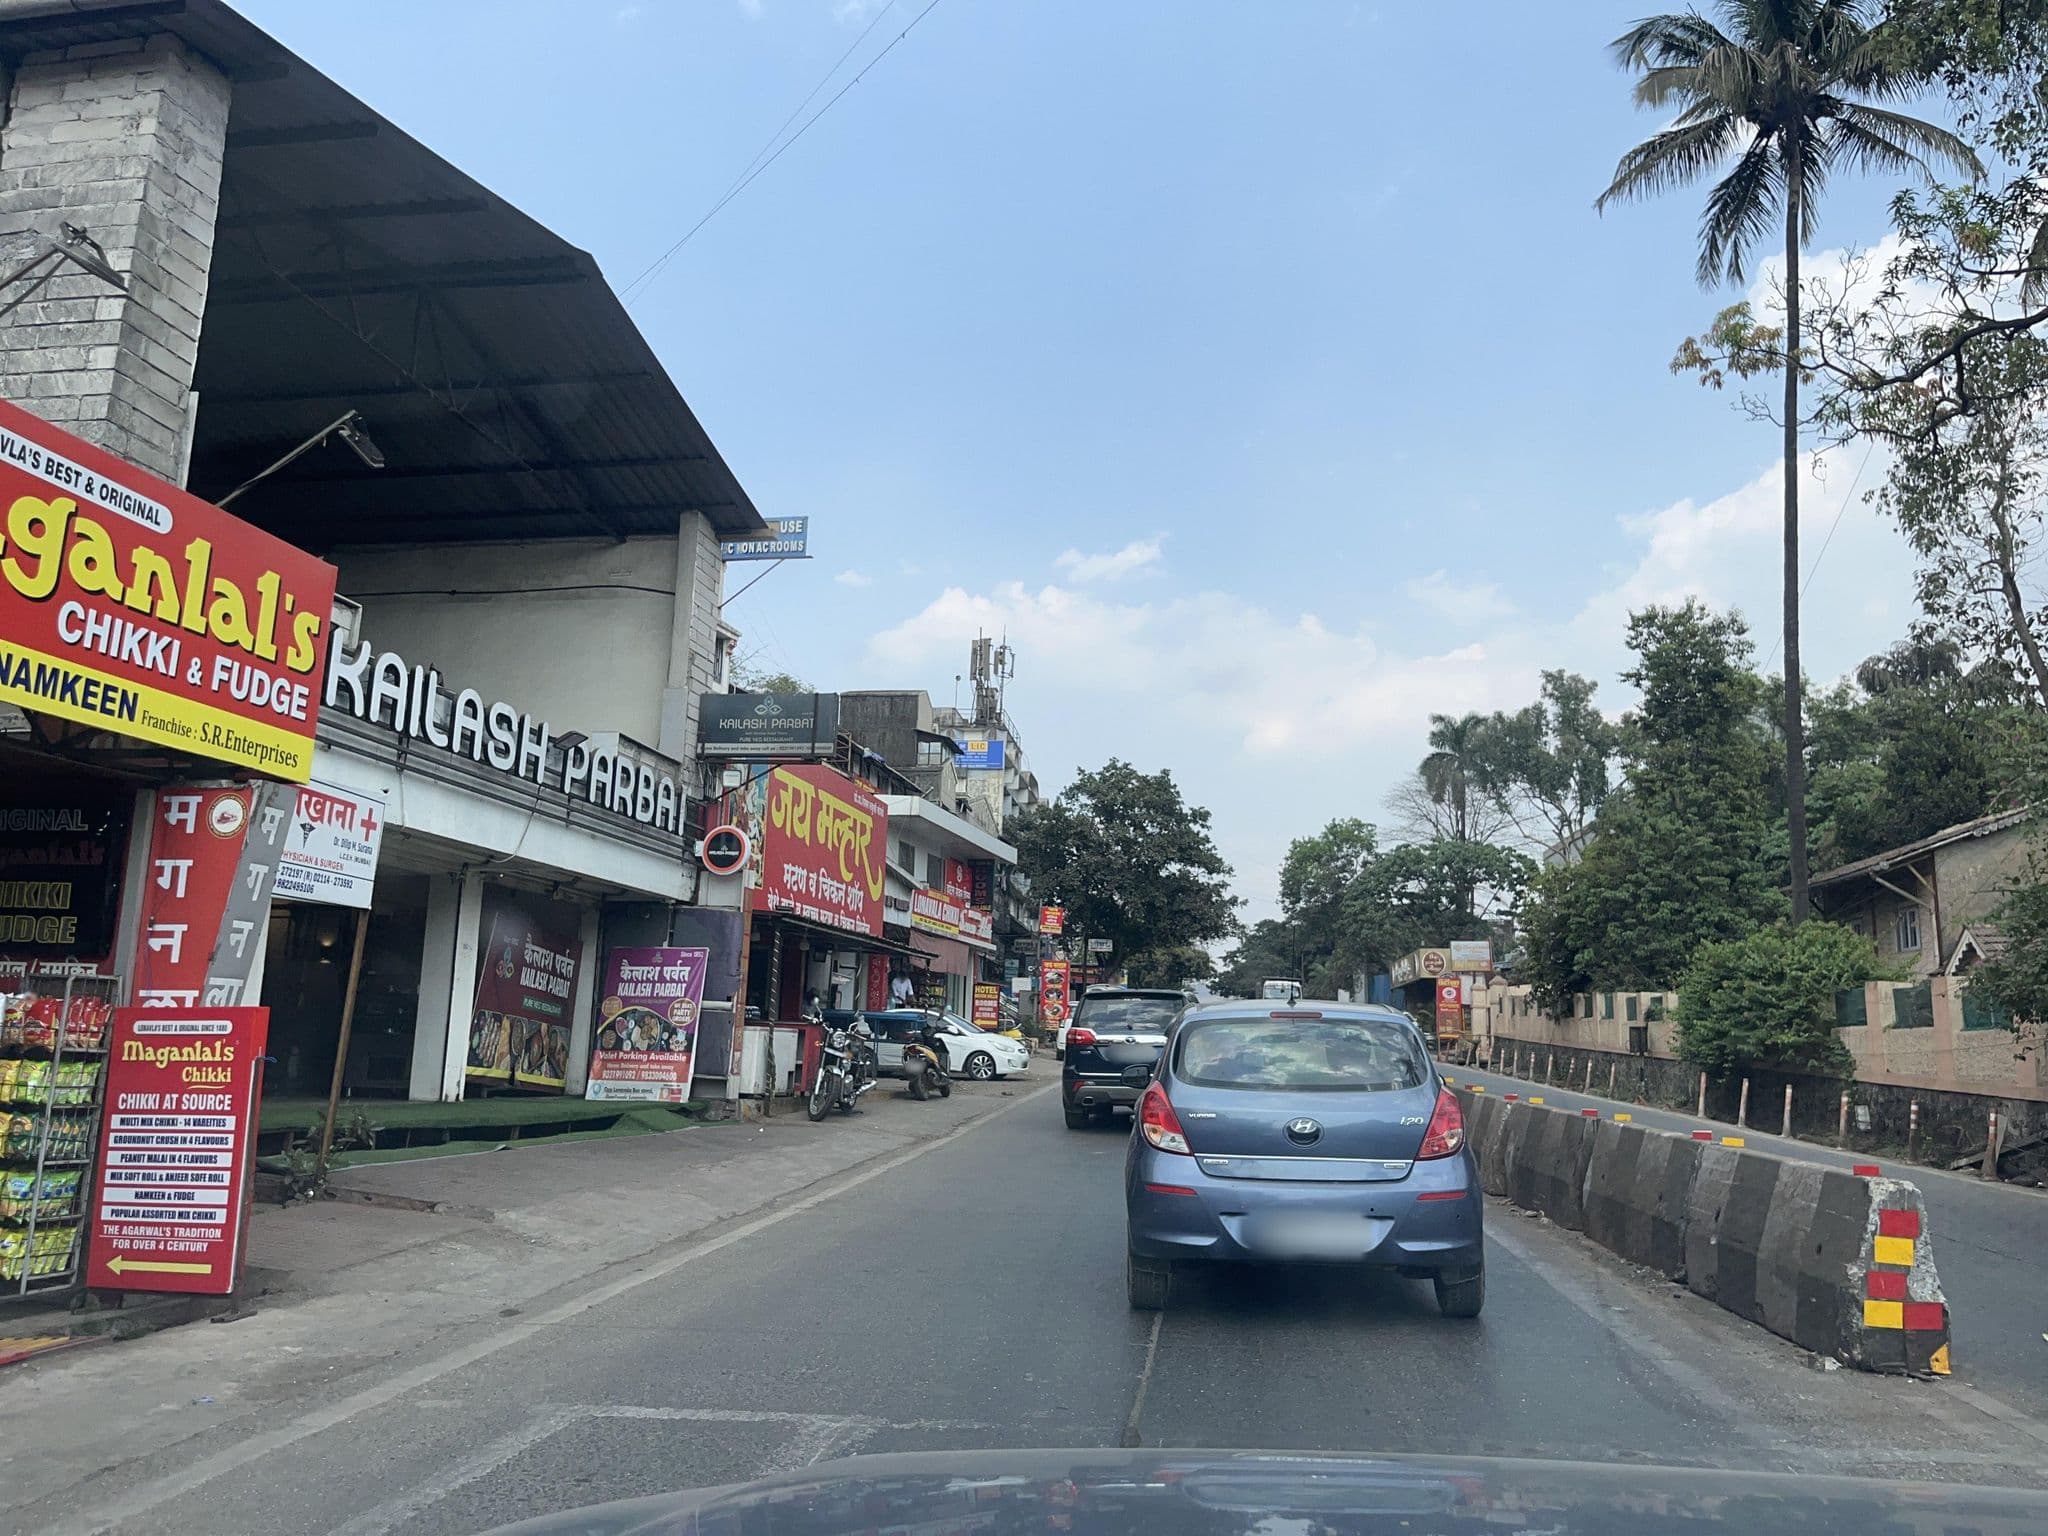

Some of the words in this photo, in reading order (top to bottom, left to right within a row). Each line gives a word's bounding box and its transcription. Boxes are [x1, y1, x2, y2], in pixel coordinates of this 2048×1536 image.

[45, 457, 82, 488] BEST
[85, 477, 94, 495] &
[100, 484, 160, 526] ORIGINAL
[780, 520, 803, 533] USE
[756, 542, 769, 553] AC
[770, 541, 804, 552] ROOMS
[0, 496, 320, 673] ganlal's
[57, 601, 180, 677] CHIKKI
[187, 657, 202, 686] &
[211, 654, 309, 721] FUDGE
[0, 653, 139, 722] NAMKEEN
[142, 709, 191, 738] Franchise
[326, 628, 549, 784] KAILASH
[719, 718, 767, 729] KAILASH
[771, 718, 815, 729] PARBAT
[771, 767, 815, 848] जय
[816, 789, 882, 902] मल्हार
[320, 859, 344, 871] SURGEN
[281, 866, 303, 879] 272197
[304, 870, 312, 881] (R)
[809, 872, 817, 898] व
[818, 867, 846, 906] चिकन
[0, 881, 72, 909] IKKI
[620, 959, 660, 981] कैलाश
[663, 960, 691, 982] पर्वत
[520, 966, 548, 991] KAILASH
[548, 975, 570, 998] PARBAT
[617, 983, 652, 997] KAILASH
[654, 983, 686, 997] PARBAT
[975, 985, 997, 994] HOTEL
[162, 1024, 174, 1032] BEST
[179, 1024, 199, 1032] ORIGINAL
[122, 1039, 234, 1068] Maganlal's
[600, 1052, 617, 1060] Valet
[618, 1052, 648, 1062] Parking
[649, 1052, 687, 1062] Available
[182, 1066, 231, 1082] Chikki
[118, 1093, 159, 1110] CHIKKI
[162, 1094, 178, 1110] AT
[181, 1094, 232, 1111] SOURCE
[120, 1117, 139, 1126] MULTI
[140, 1117, 153, 1127] MIX
[154, 1118, 178, 1127] CHIKKI
[184, 1118, 191, 1127] 14
[113, 1135, 155, 1144] GROUNDNUT
[156, 1136, 179, 1145] CRUSH
[180, 1136, 188, 1145] IN
[189, 1136, 193, 1145] 4
[194, 1136, 228, 1145] FLAVOURS
[120, 1154, 145, 1163] PEANUT
[147, 1154, 167, 1163] MALAI
[169, 1154, 177, 1164] IN
[177, 1154, 182, 1164] 4
[183, 1154, 218, 1164] FLAVOURS
[110, 1172, 123, 1181] MIX
[124, 1172, 140, 1181] SOFT
[141, 1172, 157, 1181] ROLL
[165, 1173, 189, 1182] ANJEER
[208, 1174, 224, 1183] ROLL
[134, 1191, 166, 1200] NAMKEEN
[173, 1192, 195, 1200] FUDGE
[110, 1209, 140, 1218] POPULAR
[141, 1209, 177, 1219] ASSORTED
[178, 1210, 190, 1219] MIX
[192, 1211, 216, 1220] CHIKKI
[103, 1225, 119, 1235] THE
[122, 1225, 171, 1236] AGARWAL'S
[174, 1227, 222, 1238] TRADITION
[113, 1239, 130, 1249] FOR
[132, 1240, 156, 1250] OVER
[159, 1241, 164, 1250] 4
[167, 1242, 209, 1252] CENTURY
